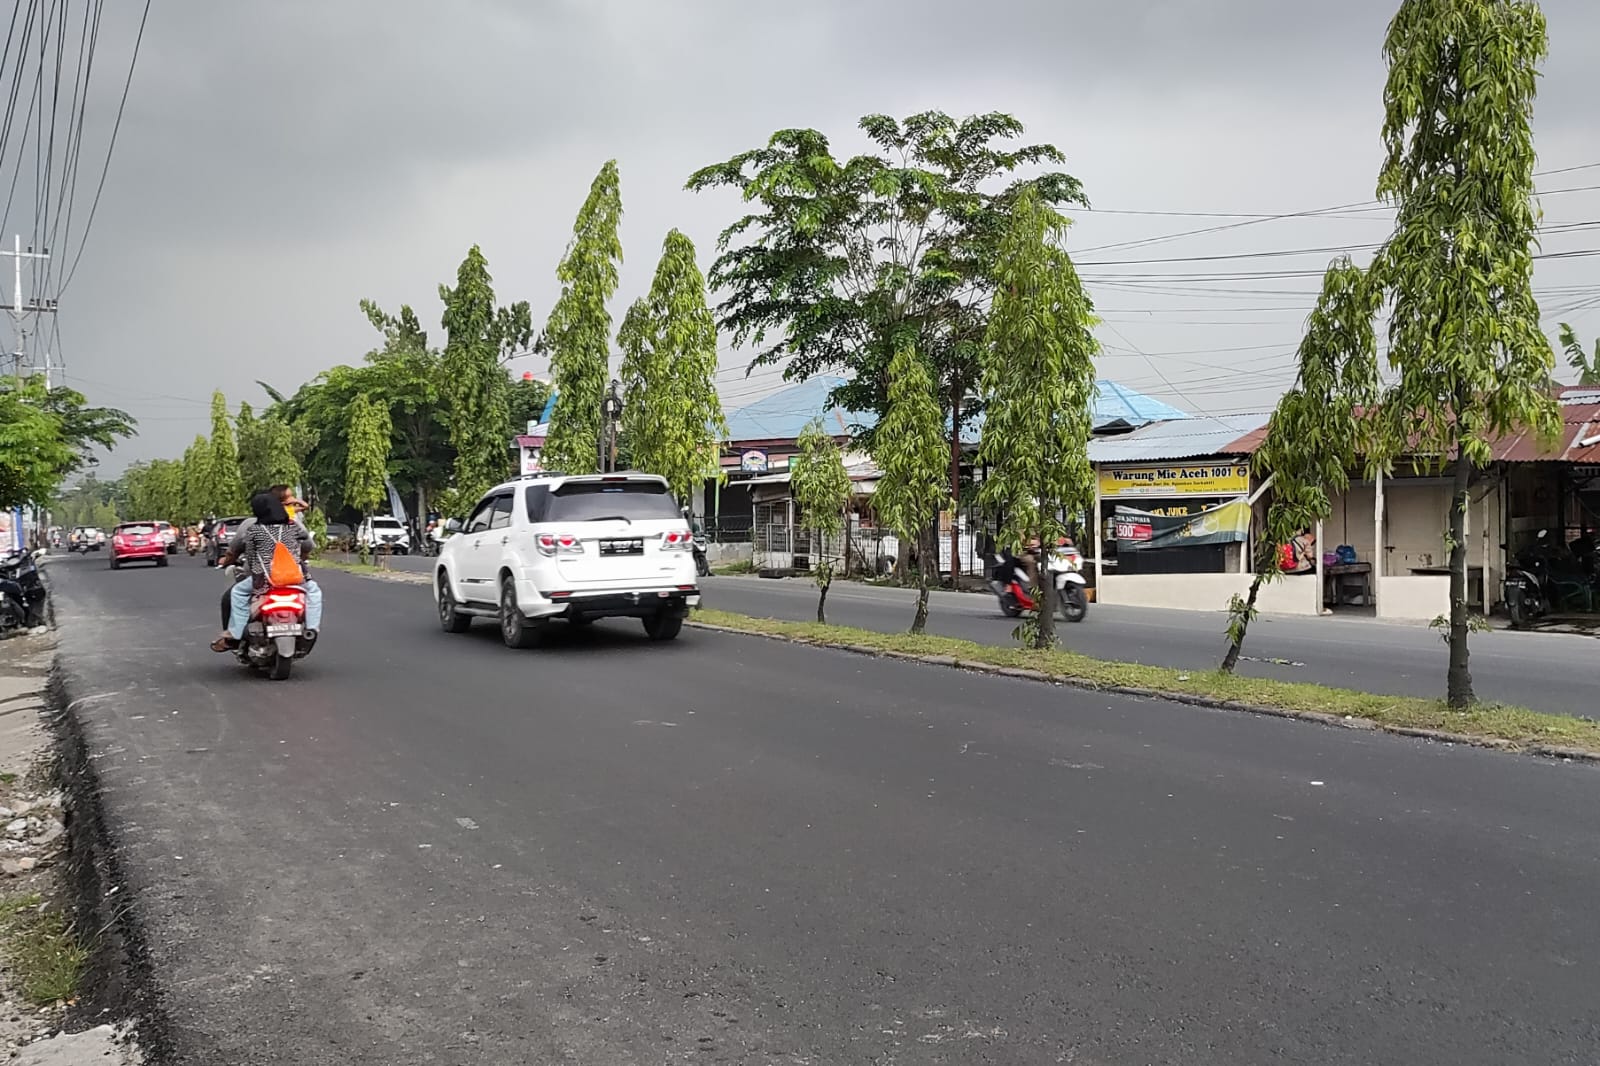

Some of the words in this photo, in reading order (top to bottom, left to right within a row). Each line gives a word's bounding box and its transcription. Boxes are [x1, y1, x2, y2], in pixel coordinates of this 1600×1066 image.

[1113, 471, 1155, 482] Warung
[1157, 469, 1177, 480] Mie
[1180, 468, 1208, 479] Aceh
[1211, 467, 1231, 477] 1001
